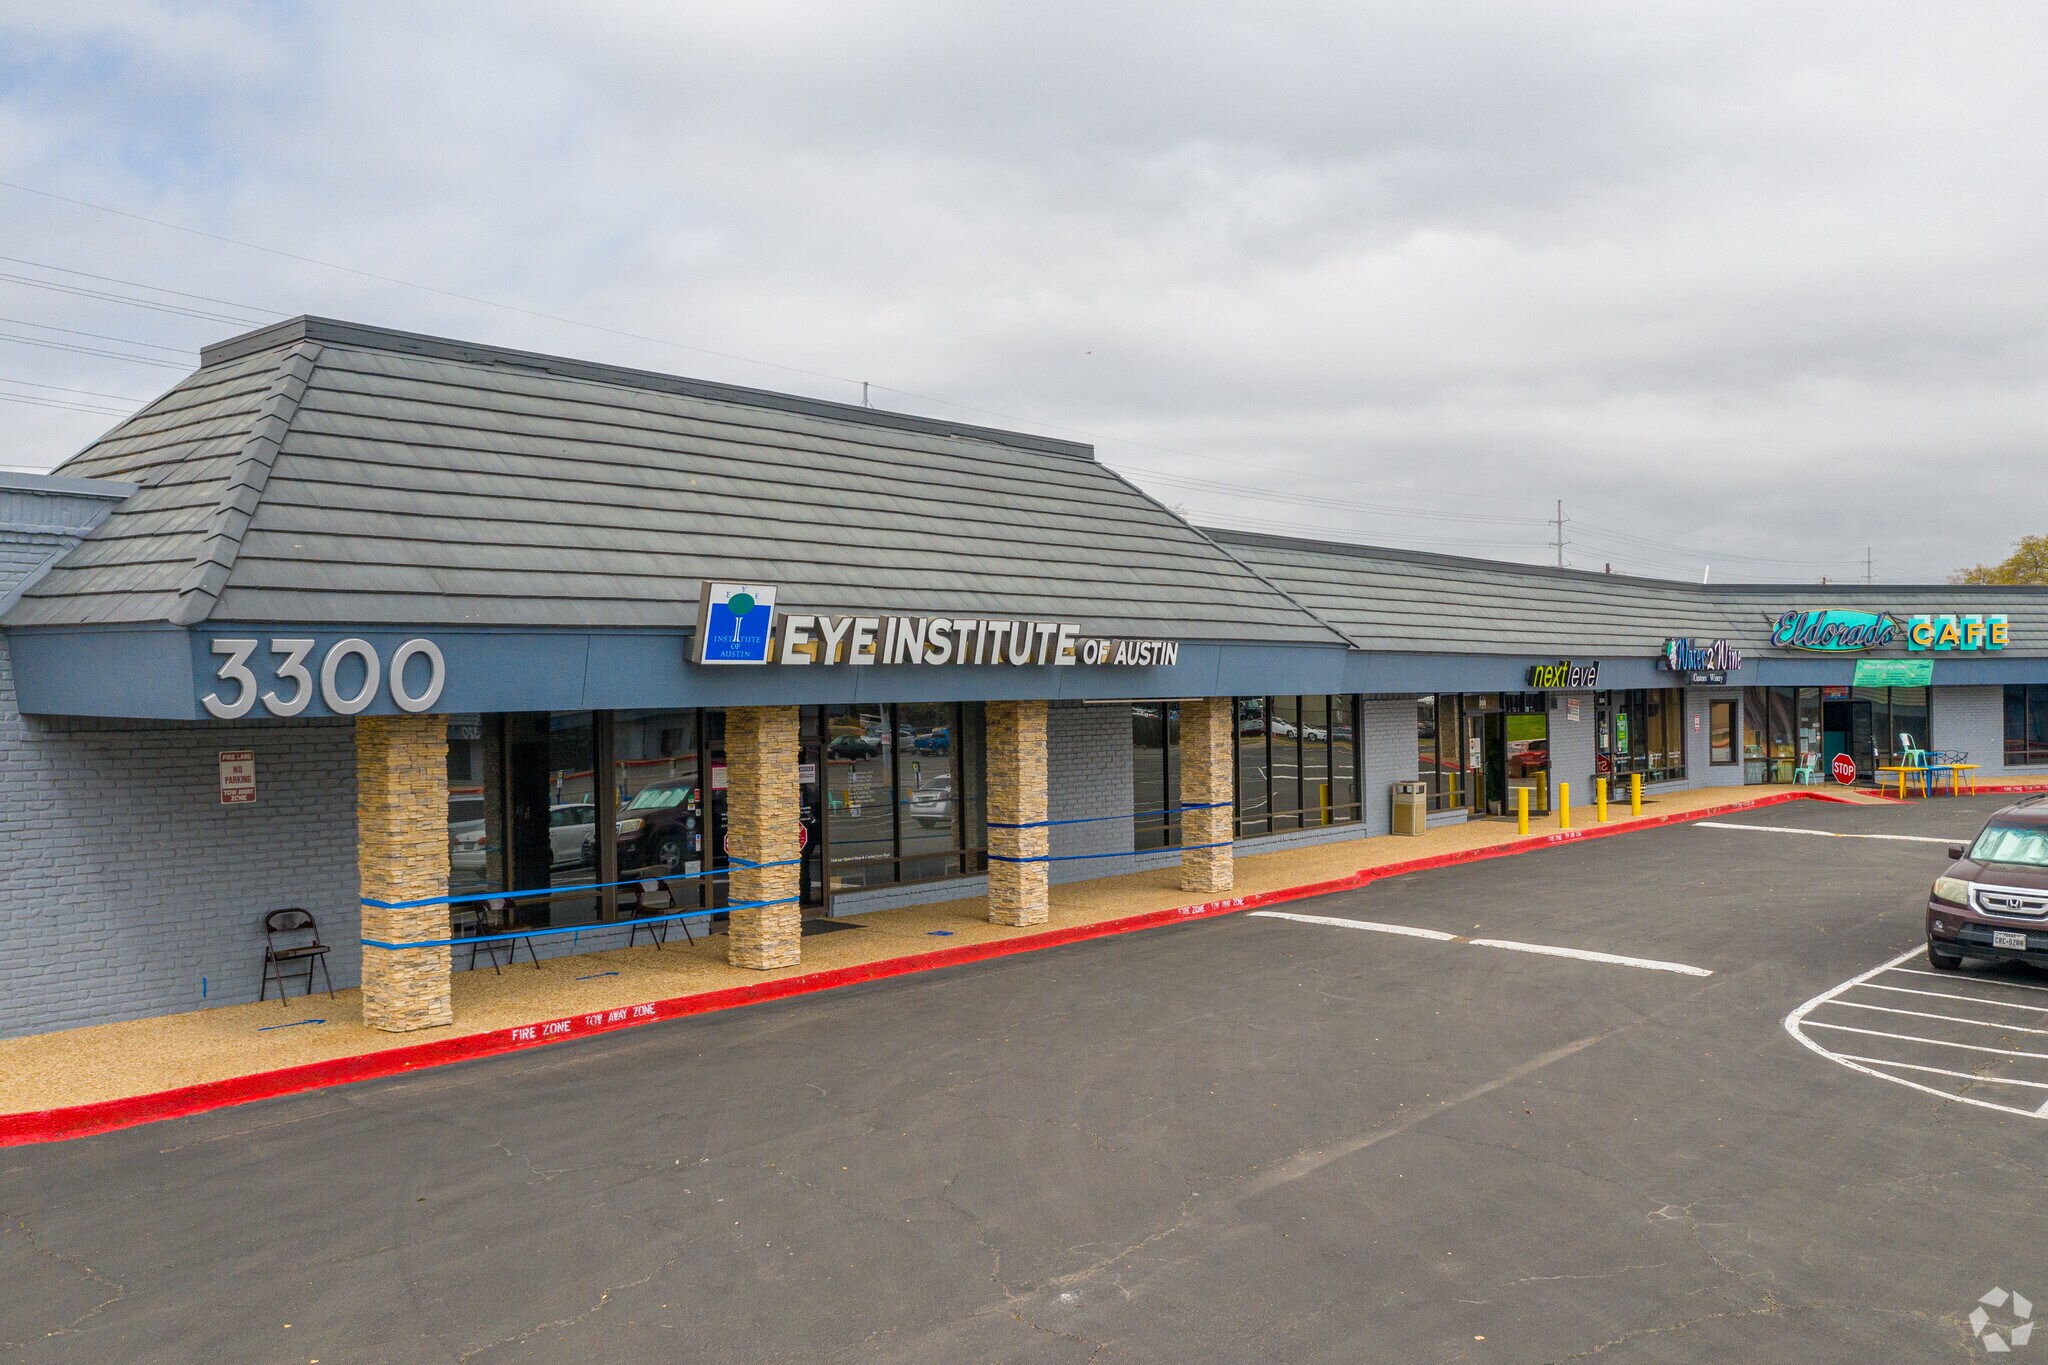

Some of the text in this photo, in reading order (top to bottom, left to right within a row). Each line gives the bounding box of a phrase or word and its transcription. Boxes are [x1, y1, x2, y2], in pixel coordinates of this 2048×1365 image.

[781, 615, 1179, 667] EYE INSTITUTE OF AUSTIN
[1770, 610, 1901, 646] Eldorado
[1912, 623, 2010, 645] CAFE
[1675, 637, 1742, 671] Water 2 Wine
[201, 638, 446, 720] 3300
[1693, 673, 1724, 683] Custom Winery
[224, 775, 252, 784] PARKING
[233, 765, 243, 774] NO
[1834, 761, 1854, 776] STOP
[512, 1003, 656, 1041] FIRE ZONE TOW AWAY ZONE
